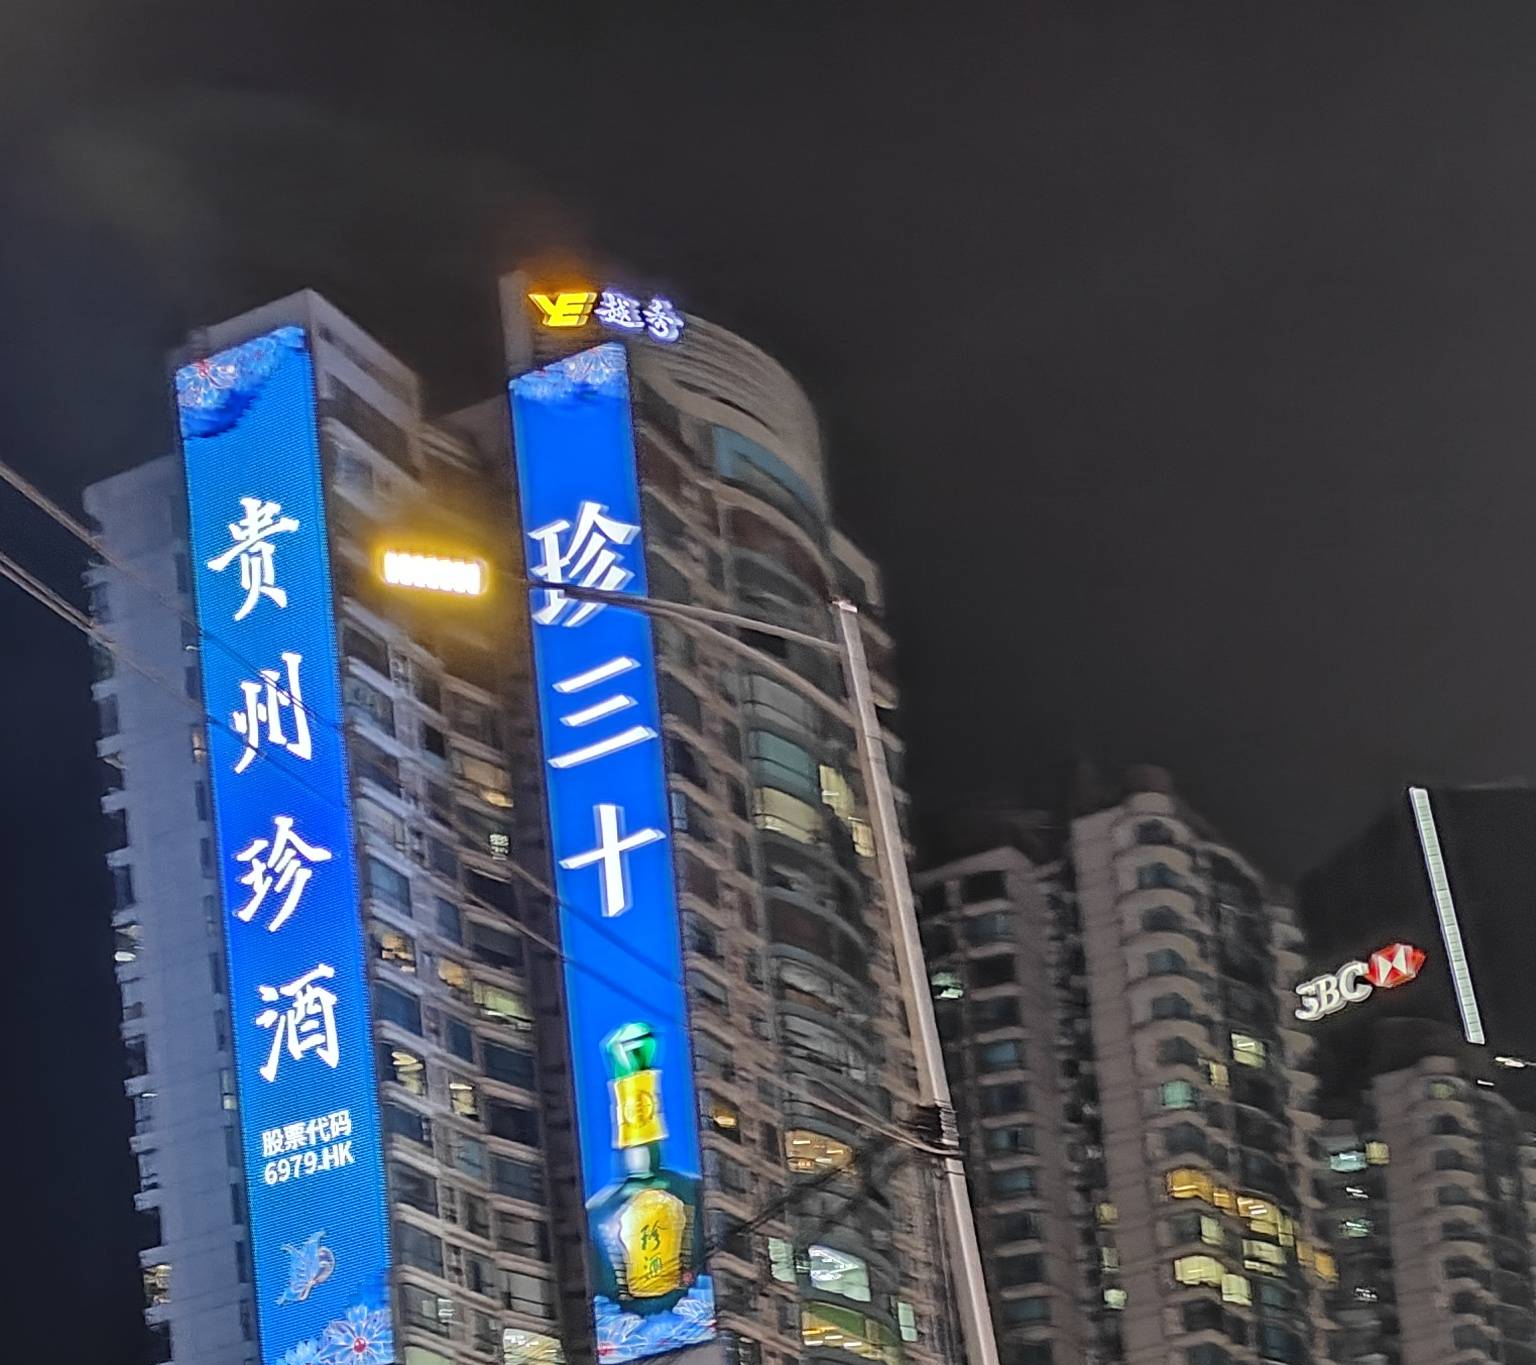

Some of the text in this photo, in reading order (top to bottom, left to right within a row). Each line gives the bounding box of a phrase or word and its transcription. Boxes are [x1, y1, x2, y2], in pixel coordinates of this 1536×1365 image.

[528, 500, 666, 918] 珍三十
[207, 497, 340, 1083] 贵州珍酒
[1294, 960, 1373, 1022] SBC
[262, 1109, 352, 1157] 股票代码
[264, 1141, 355, 1185] 6979.HK
[640, 1220, 667, 1281] 珍酒
